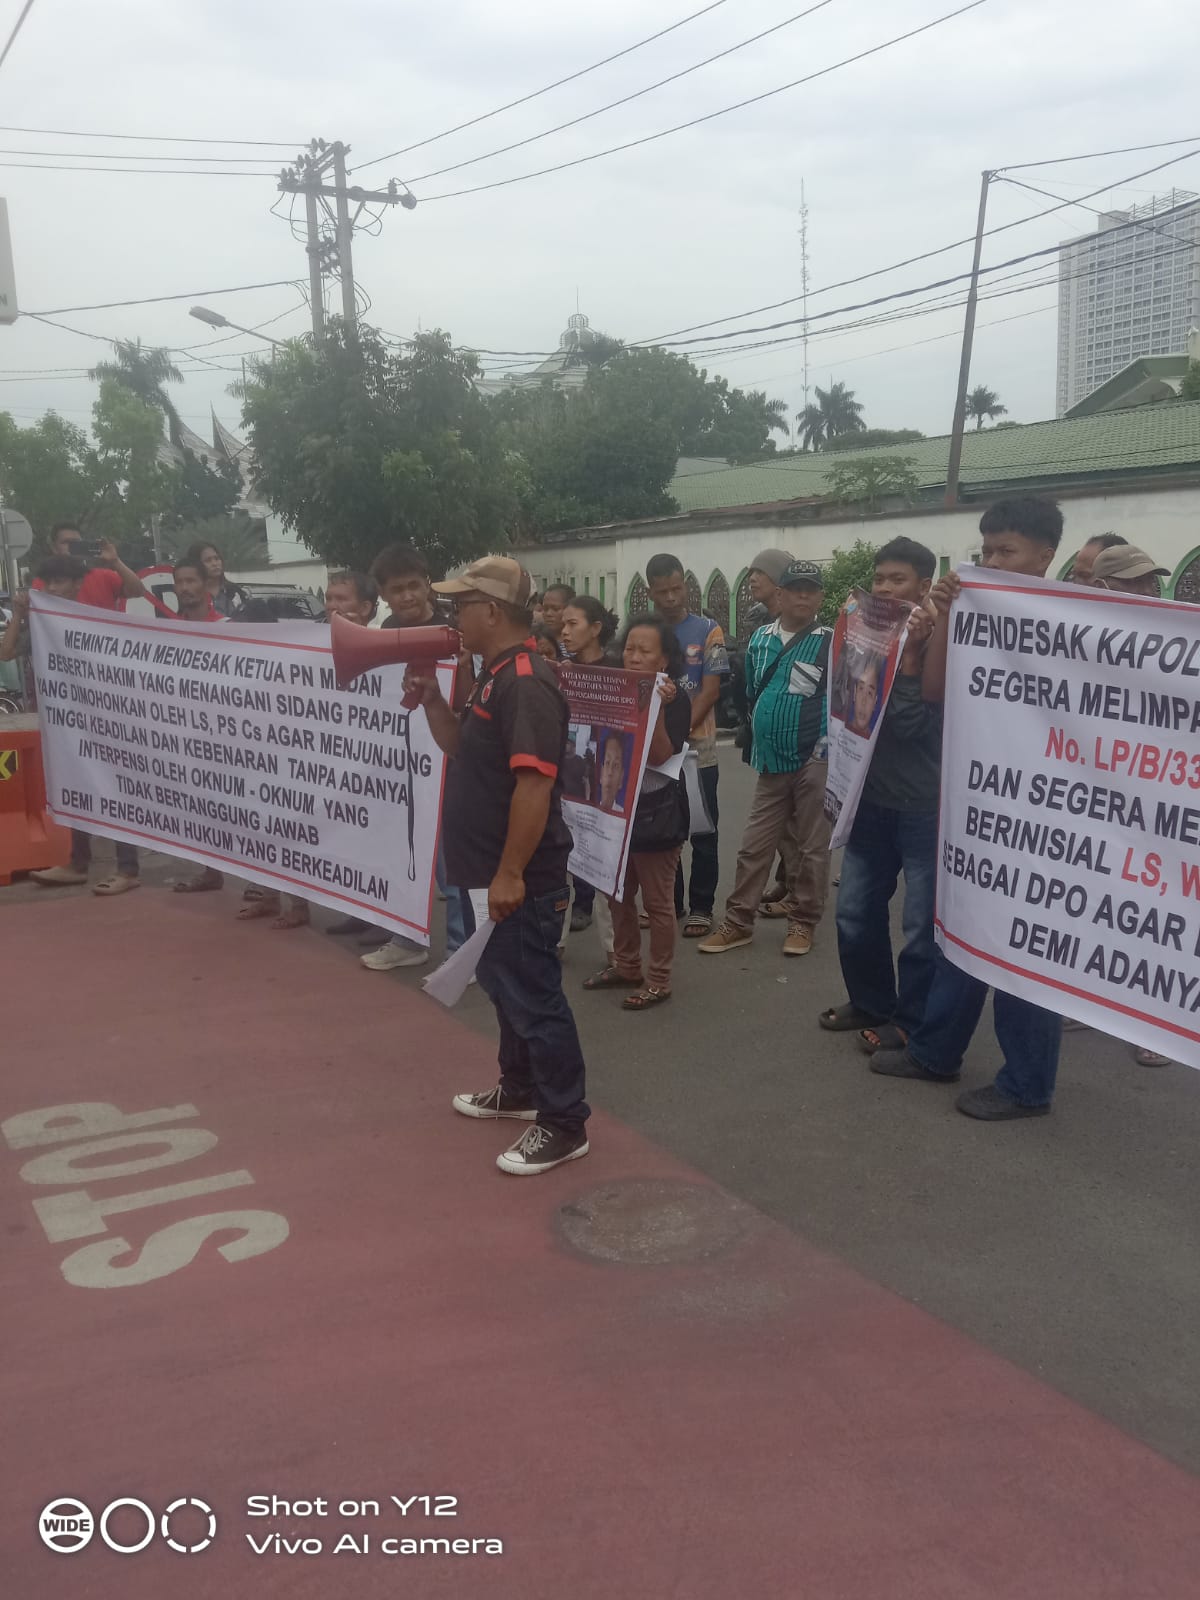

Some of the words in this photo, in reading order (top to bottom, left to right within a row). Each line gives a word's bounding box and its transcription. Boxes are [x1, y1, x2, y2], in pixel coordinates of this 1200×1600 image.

[64, 629, 119, 656] MEMINTA
[121, 639, 152, 661] DAN
[152, 644, 232, 675] MENDESAK
[234, 654, 286, 684] KETUA
[290, 663, 314, 687] PN
[320, 667, 382, 698] MDAN
[953, 611, 1093, 662] MENDESAK
[1096, 627, 1200, 677] KAPOL
[48, 653, 96, 680] BESERTA
[97, 667, 135, 689] HAKIM
[138, 672, 175, 696] YANG
[179, 677, 271, 713] MENANGANI
[277, 693, 343, 724] SIDANG
[968, 666, 1070, 713] SEGERA
[37, 677, 68, 700] YANG
[70, 683, 147, 719] DIMOHONKAN
[150, 701, 187, 727] OLEH
[190, 708, 214, 736] LS,
[217, 713, 237, 737] PS
[242, 718, 262, 741] Cs
[266, 723, 315, 752] AGAR
[320, 731, 432, 777] MENJUNJUNG
[45, 705, 88, 731] TINGGI
[90, 715, 148, 747] KEADILAN
[151, 730, 179, 755] DAN
[182, 736, 278, 775] KEBENARAN
[287, 756, 337, 789] TANPA
[339, 771, 409, 807] ADANYA
[1045, 726, 1086, 766] No.
[79, 738, 150, 774] INTERPENSI
[152, 758, 187, 785] OLEH
[191, 767, 245, 798] OKNUM
[259, 782, 315, 815] OKNUM
[323, 797, 369, 829] YANG
[116, 774, 153, 801] TIDAK
[155, 785, 260, 831] BERTANGGUNG
[265, 815, 320, 846] JAWAB
[968, 759, 1023, 800] DAN
[1028, 773, 1146, 832] SEGERA
[62, 788, 93, 812] DEMI
[101, 797, 180, 835] PENEGAKAN
[184, 820, 233, 852] HUKUM
[236, 834, 277, 864] YANG
[281, 847, 389, 902] BERKEADILAN
[965, 805, 1112, 875] BERINISIAL
[1121, 847, 1168, 896] LS,
[942, 839, 1020, 898] SEBAGAI
[1025, 872, 1088, 918] DPO
[1092, 894, 1186, 951] AGAR
[1008, 916, 1081, 969] DEMI
[0, 1101, 290, 1289] STOP
